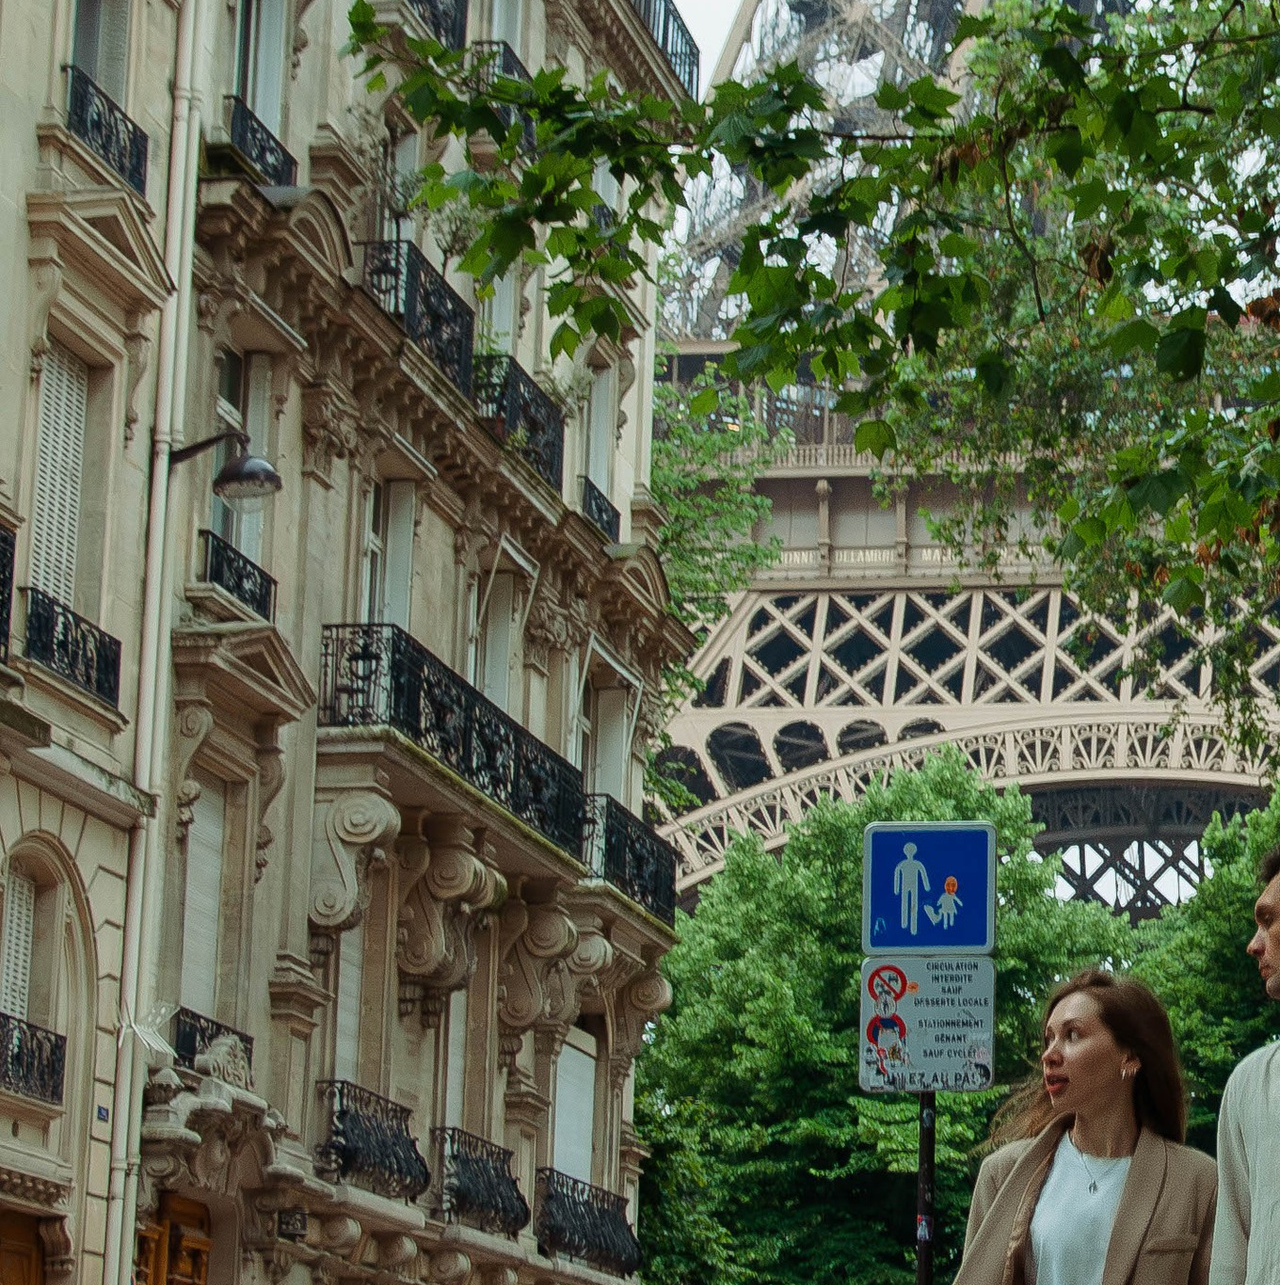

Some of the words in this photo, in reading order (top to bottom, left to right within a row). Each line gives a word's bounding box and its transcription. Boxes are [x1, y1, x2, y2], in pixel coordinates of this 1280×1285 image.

[926, 961, 979, 972] CIRCULATION
[931, 974, 973, 984] INTERDITE
[941, 985, 963, 995] SAUF
[913, 997, 955, 1007] DESSERTE
[957, 997, 990, 1007] LOCALE
[918, 1018, 984, 1029] STATIONNEMENT
[923, 1049, 945, 1059] SAUF
